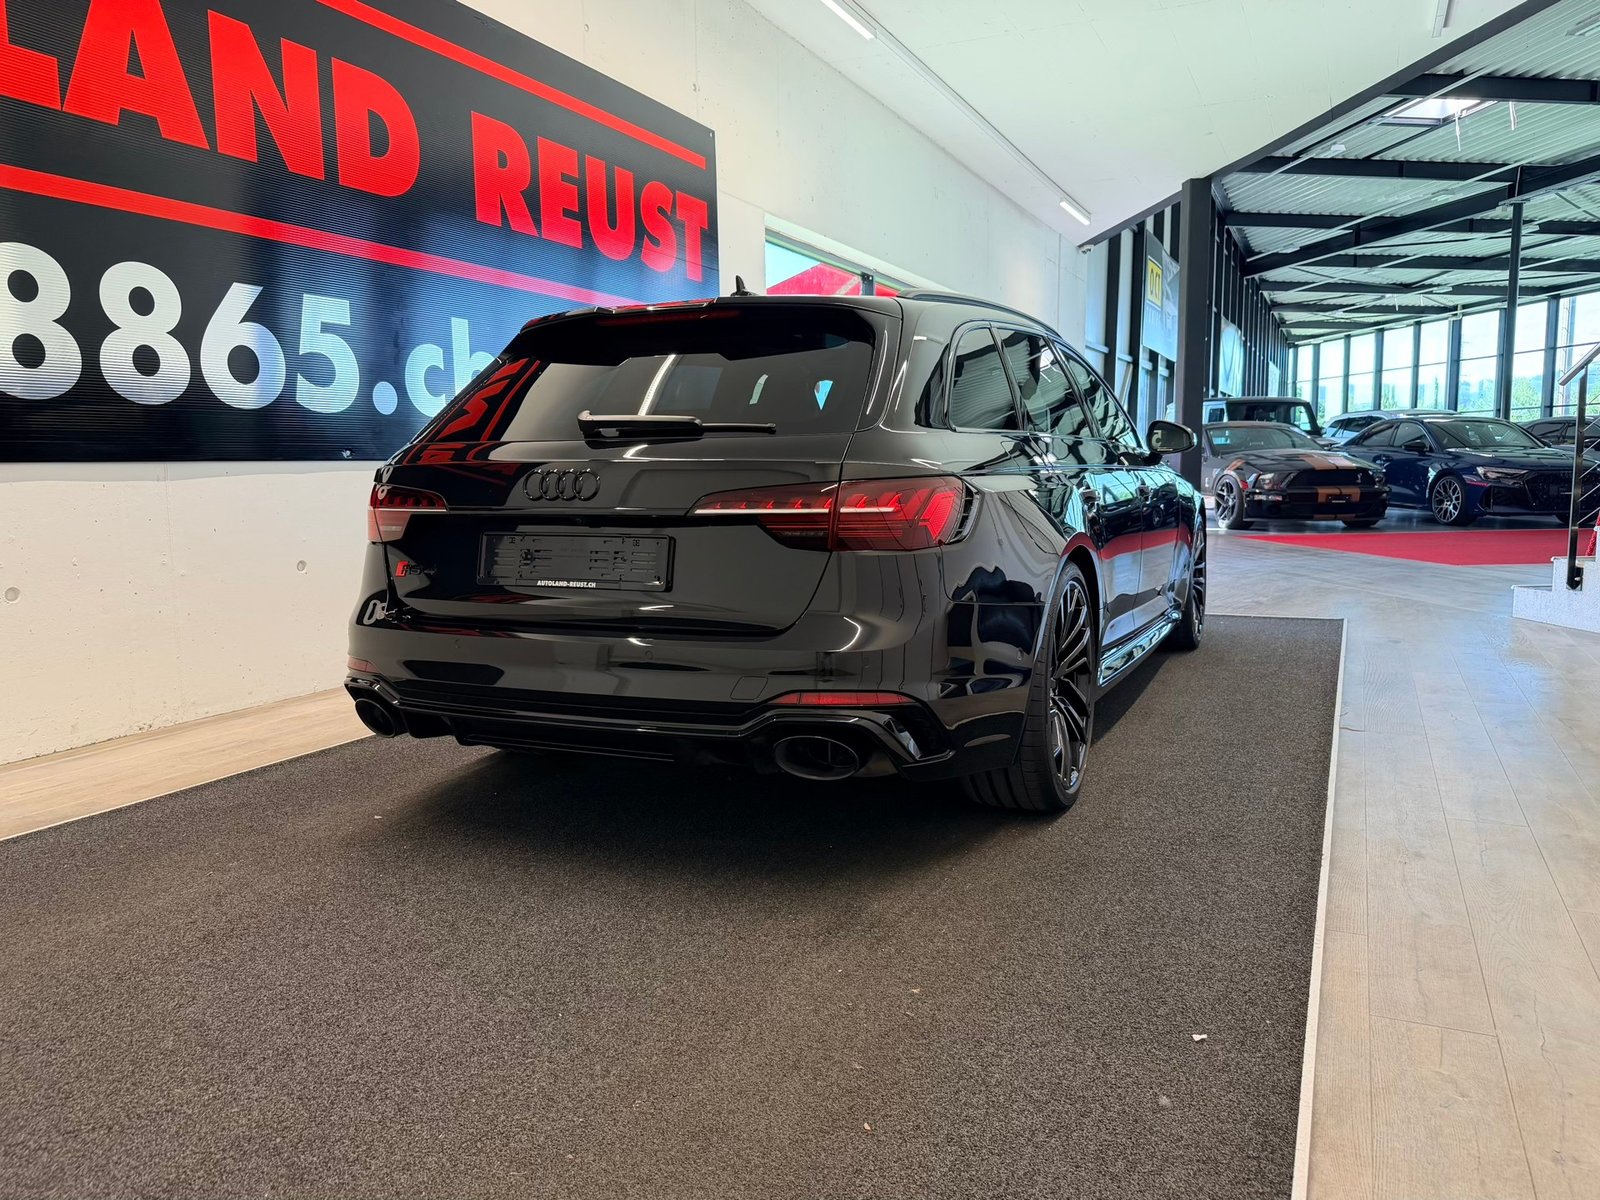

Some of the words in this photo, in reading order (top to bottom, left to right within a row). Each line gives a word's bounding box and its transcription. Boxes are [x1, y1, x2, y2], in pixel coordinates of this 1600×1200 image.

[0, 0, 420, 197] AND
[471, 110, 708, 283] REUST
[536, 580, 597, 588] AUTOLAND-REUST.CH
